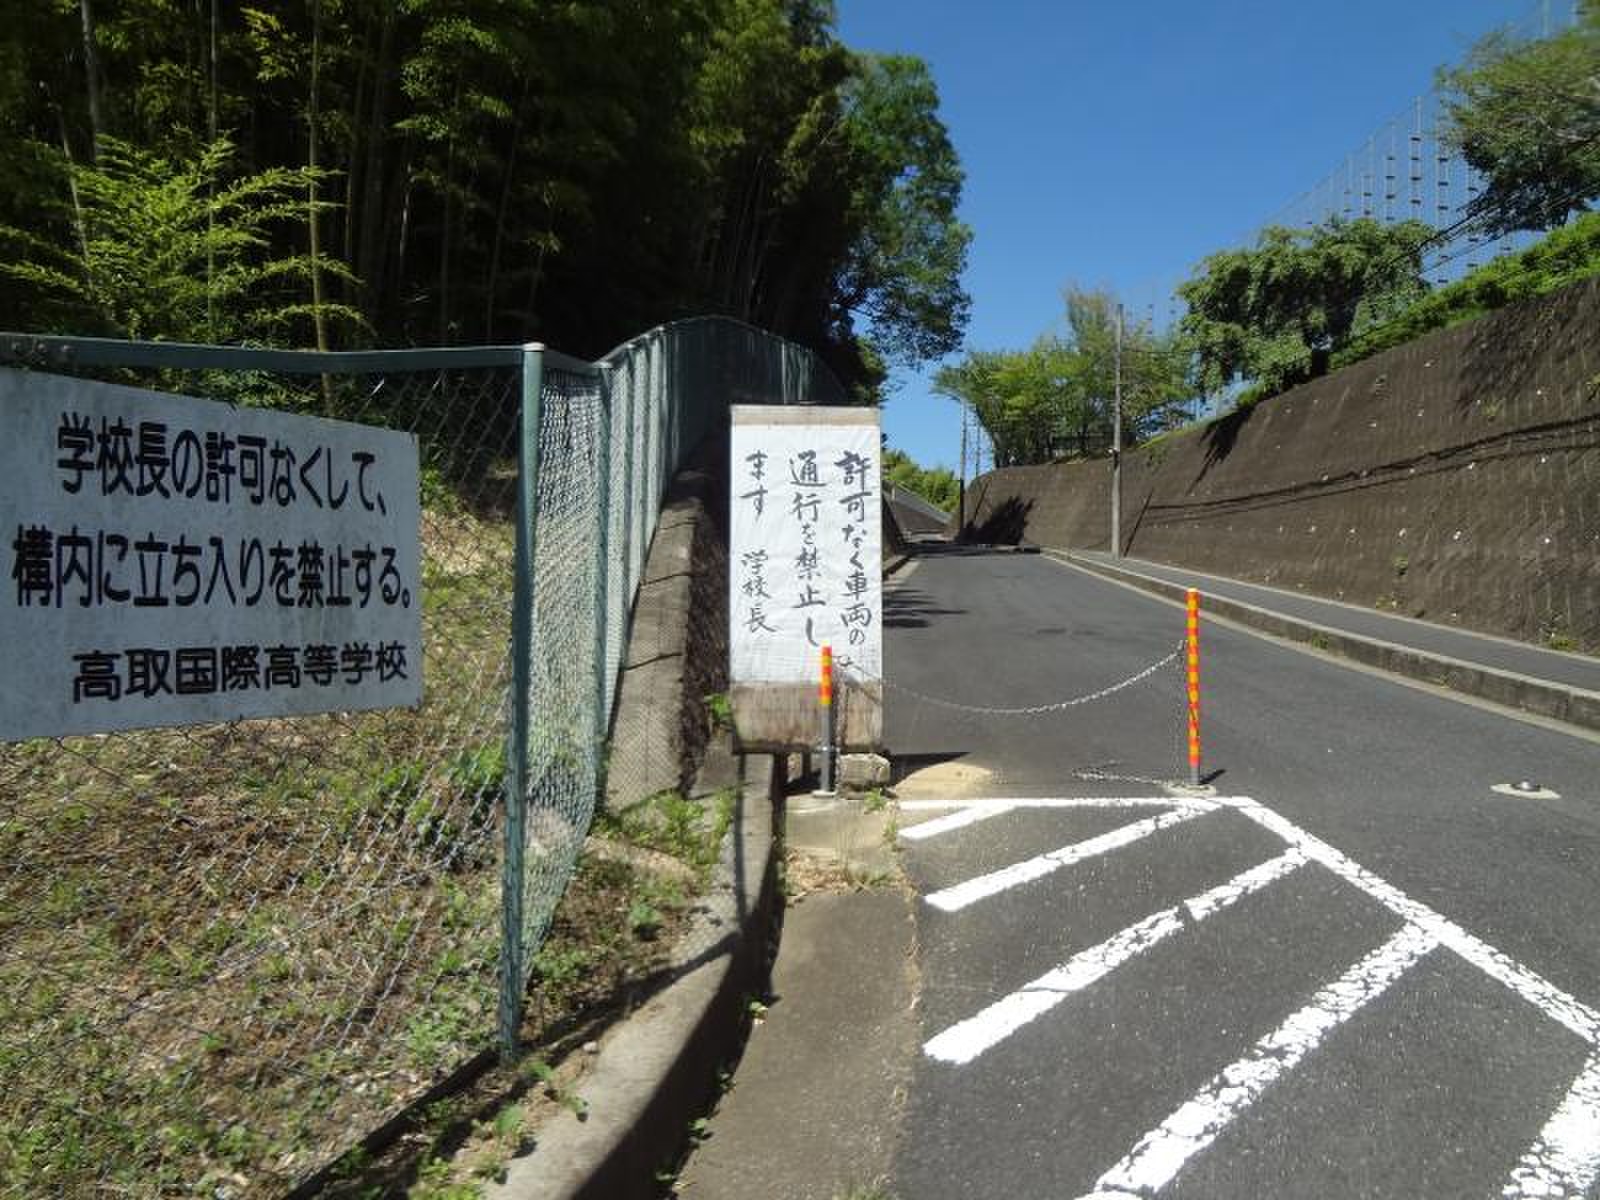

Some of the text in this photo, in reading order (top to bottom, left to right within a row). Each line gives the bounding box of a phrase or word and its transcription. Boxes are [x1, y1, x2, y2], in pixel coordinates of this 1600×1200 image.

[57, 411, 387, 516] 学校長の許可なくして、
[12, 523, 411, 609] 構内に立ち入りを禁止する。
[740, 450, 782, 634] ます 学校長
[789, 450, 828, 648] 通行を禁止し
[833, 450, 873, 646] 許可なく車両の
[72, 640, 408, 703] 高取国際高等学校
